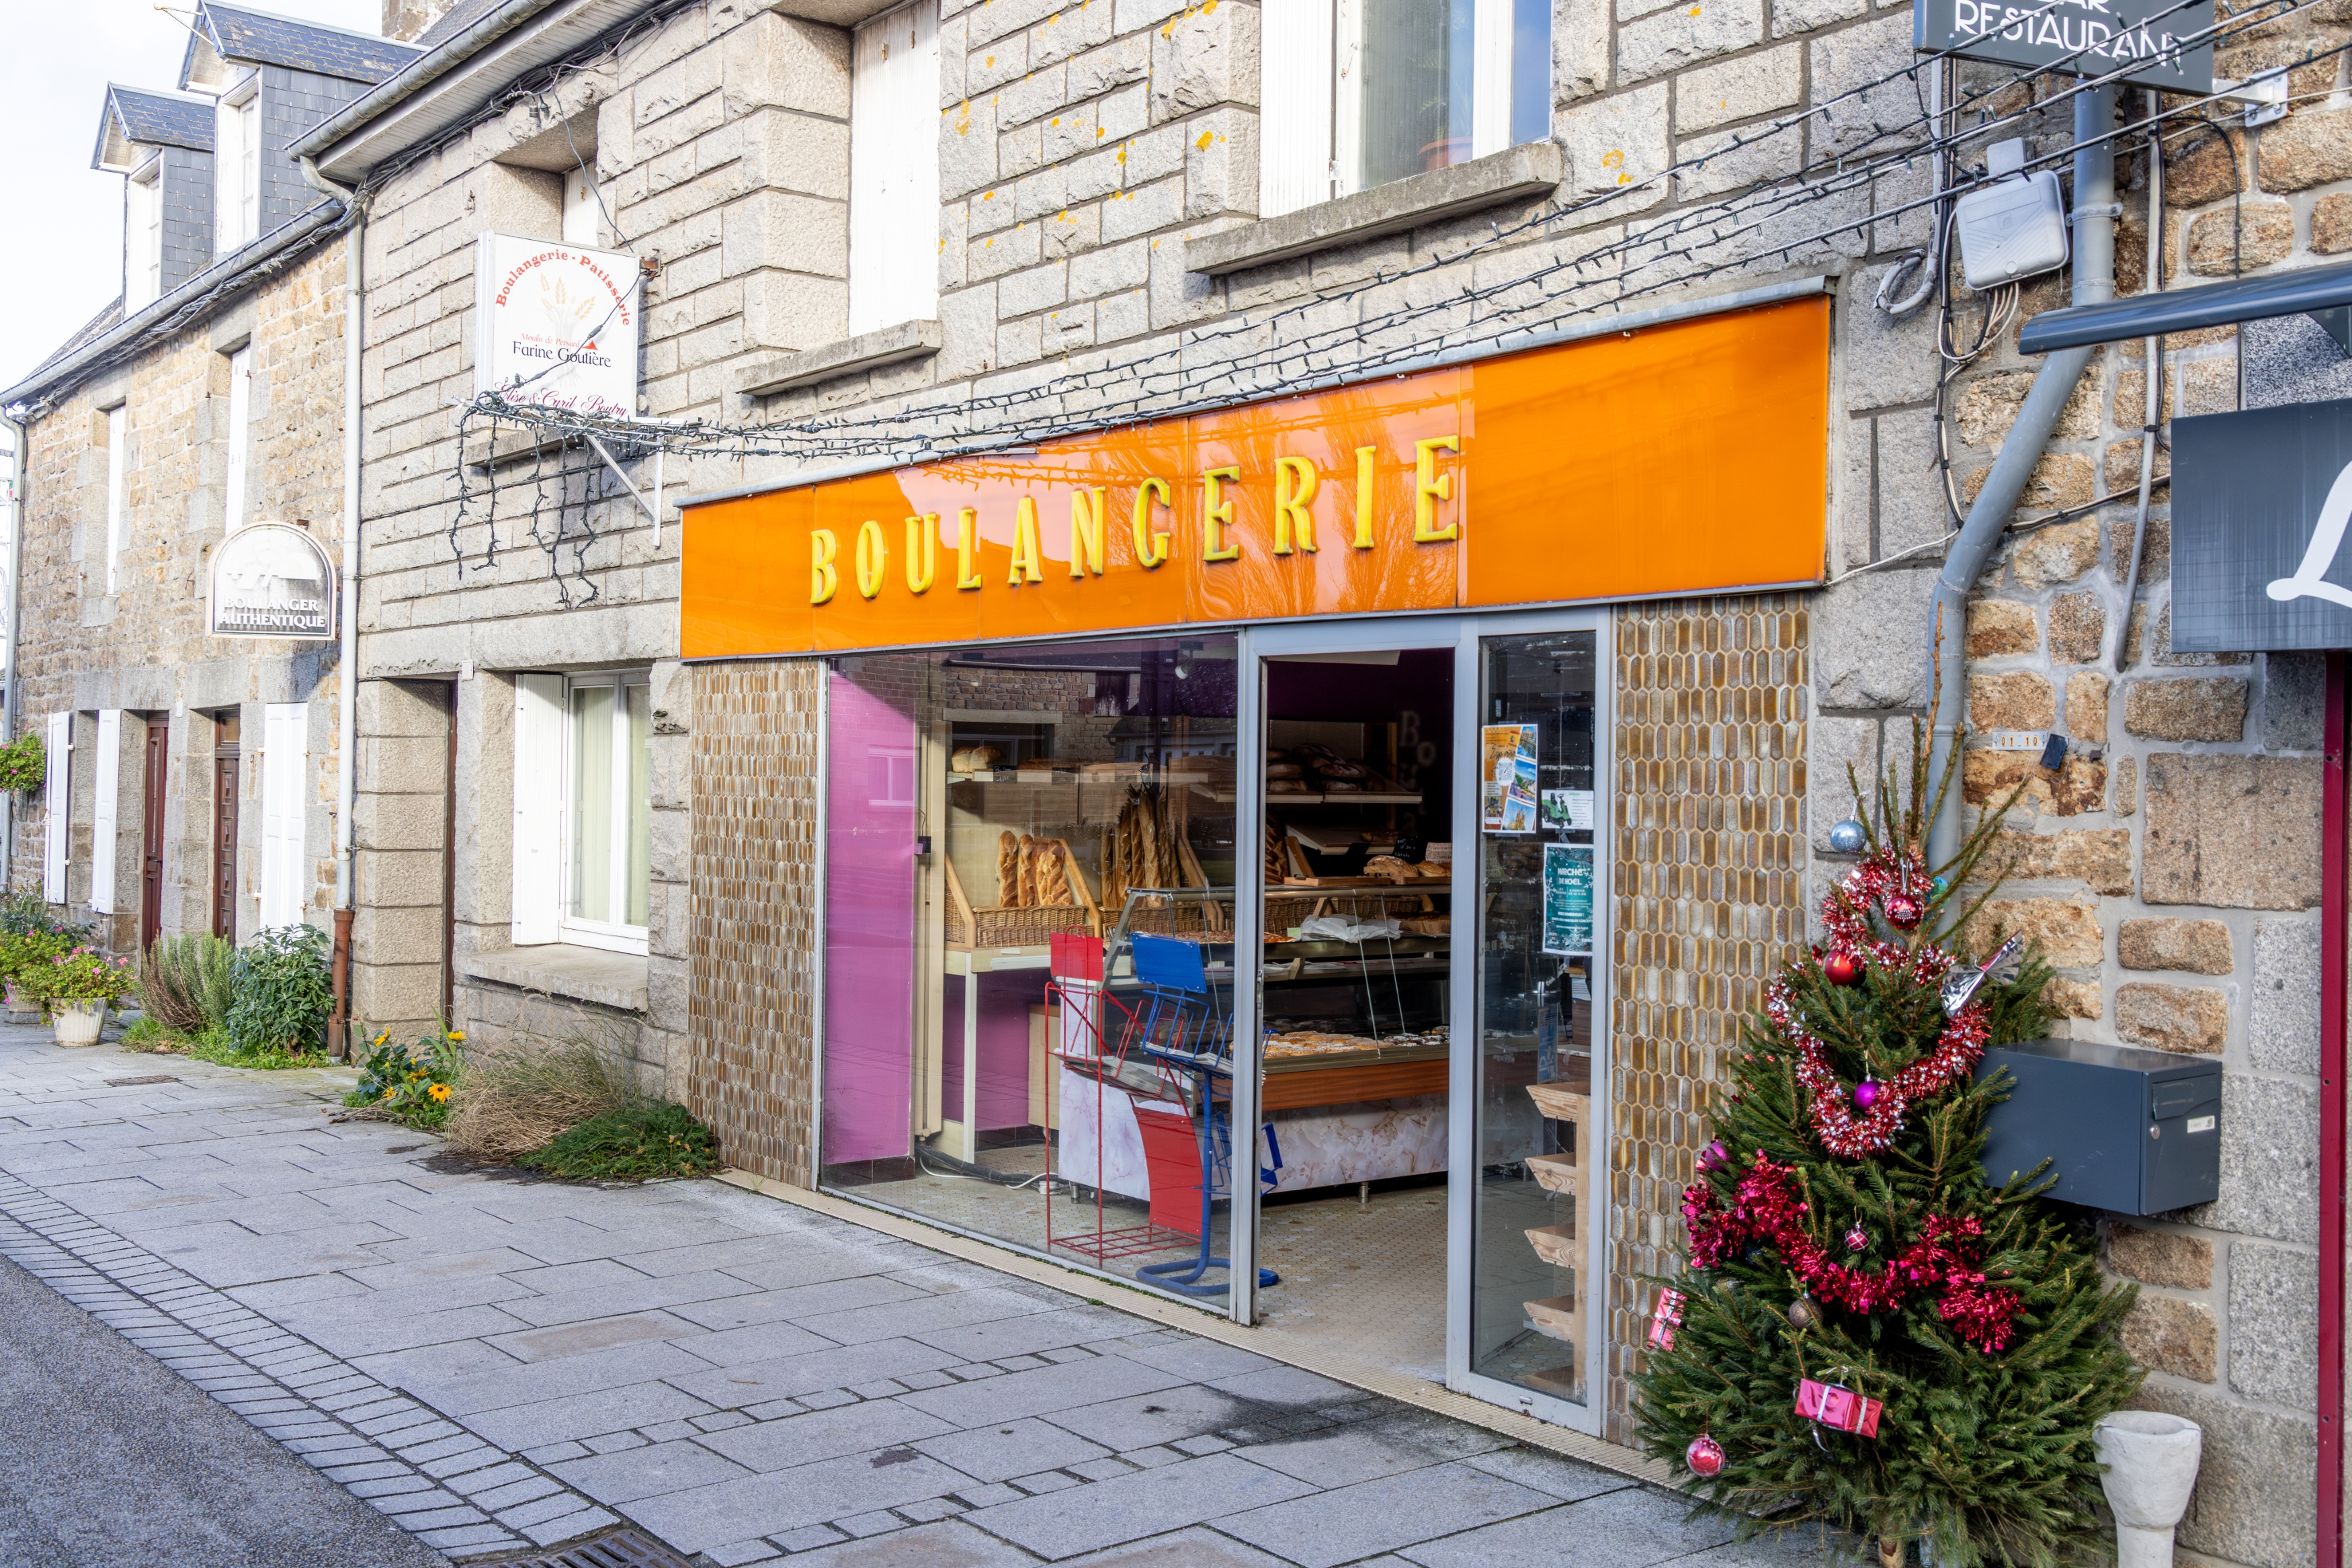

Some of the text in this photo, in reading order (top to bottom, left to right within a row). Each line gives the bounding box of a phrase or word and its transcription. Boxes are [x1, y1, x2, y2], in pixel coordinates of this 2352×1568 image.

[1954, 0, 2182, 67] RESTAURANT
[495, 249, 569, 308] Boulangerie
[579, 255, 630, 326] Pâtisserie
[521, 333, 543, 343] Moulin
[545, 335, 553, 344] de
[513, 341, 612, 367] Farine Goutière
[581, 394, 629, 417] Boutry
[810, 434, 1460, 606] BOULANGERIE
[224, 597, 319, 611] BOULANGER
[219, 612, 326, 629] AUTHENTIQUE
